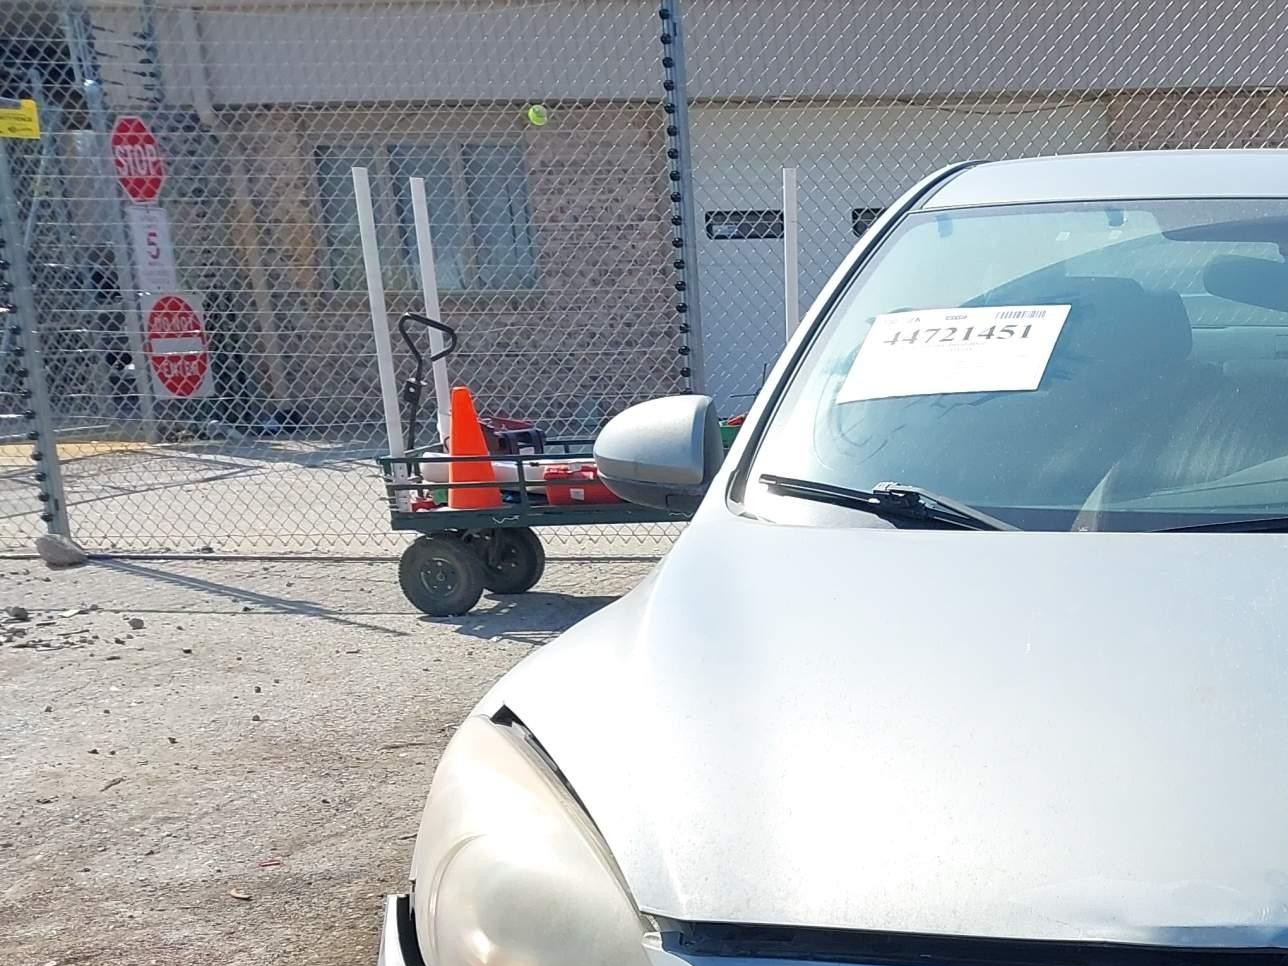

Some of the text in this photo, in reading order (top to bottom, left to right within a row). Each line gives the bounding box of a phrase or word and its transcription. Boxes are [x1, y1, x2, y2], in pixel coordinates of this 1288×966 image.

[115, 144, 158, 176] STOP
[147, 232, 160, 259] 5
[152, 315, 196, 333] DO NOT
[883, 323, 1033, 346] 44721451
[160, 358, 199, 378] ENTER
